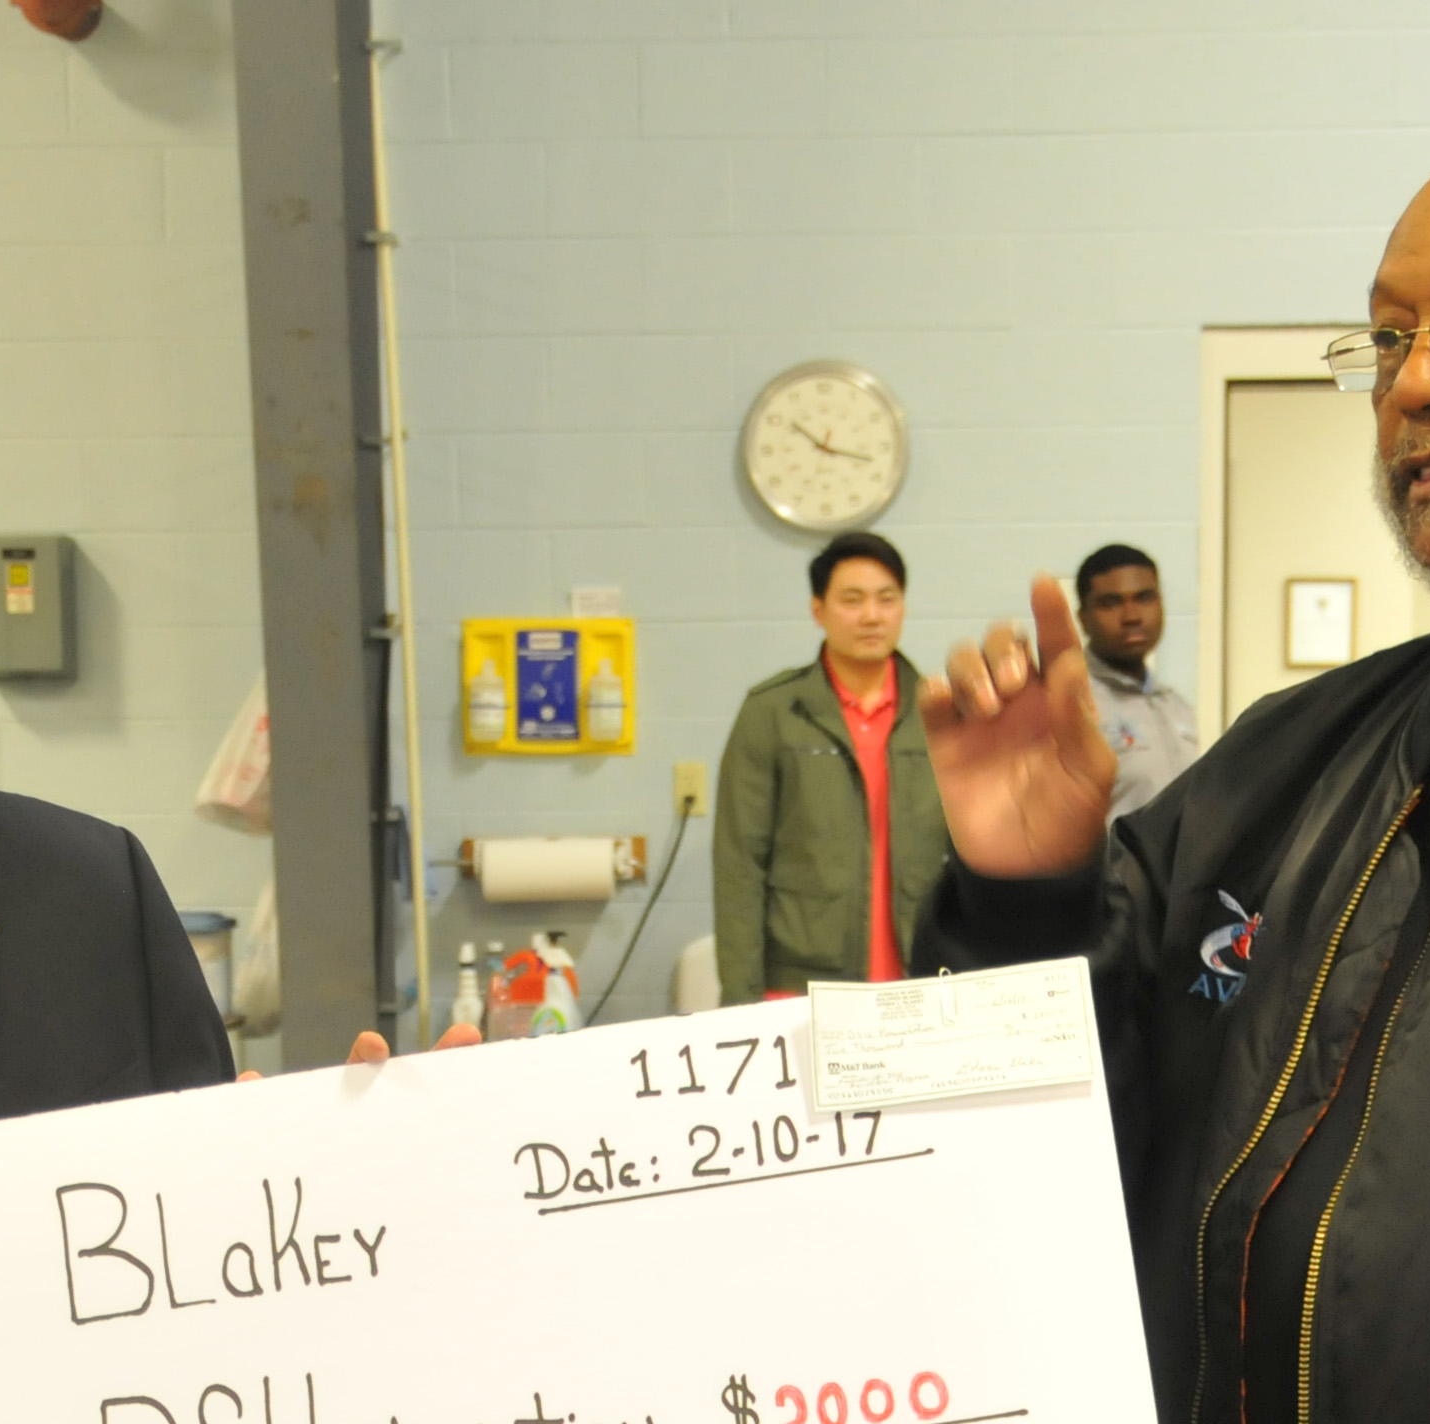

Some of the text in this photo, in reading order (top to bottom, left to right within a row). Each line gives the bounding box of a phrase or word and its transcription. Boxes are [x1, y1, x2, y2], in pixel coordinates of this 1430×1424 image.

[629, 1035, 799, 1099] 1171
[862, 1060, 887, 1071] Bank
[687, 1110, 884, 1178] 2-10-17
